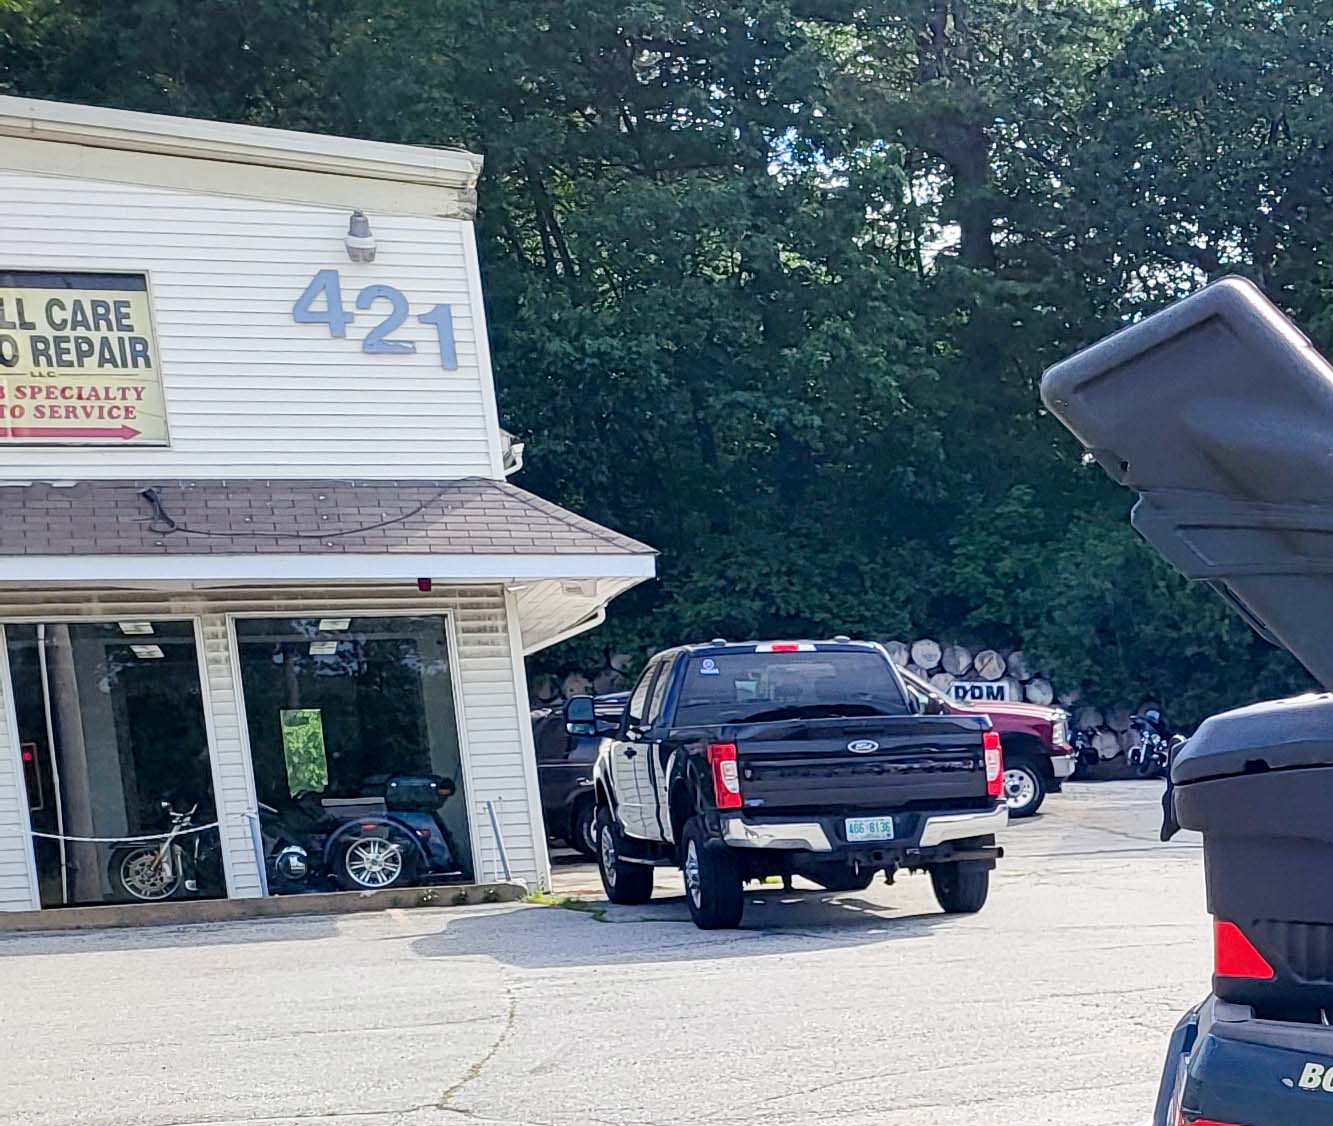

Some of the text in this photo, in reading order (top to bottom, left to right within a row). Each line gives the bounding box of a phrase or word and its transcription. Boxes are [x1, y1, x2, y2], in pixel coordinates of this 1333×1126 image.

[45, 297, 134, 332] CARE
[292, 269, 458, 371] 421
[30, 335, 152, 368] REPAIR
[15, 385, 146, 400] SPECIALTY
[33, 404, 137, 420] SERVICE
[954, 684, 1005, 701] DDM
